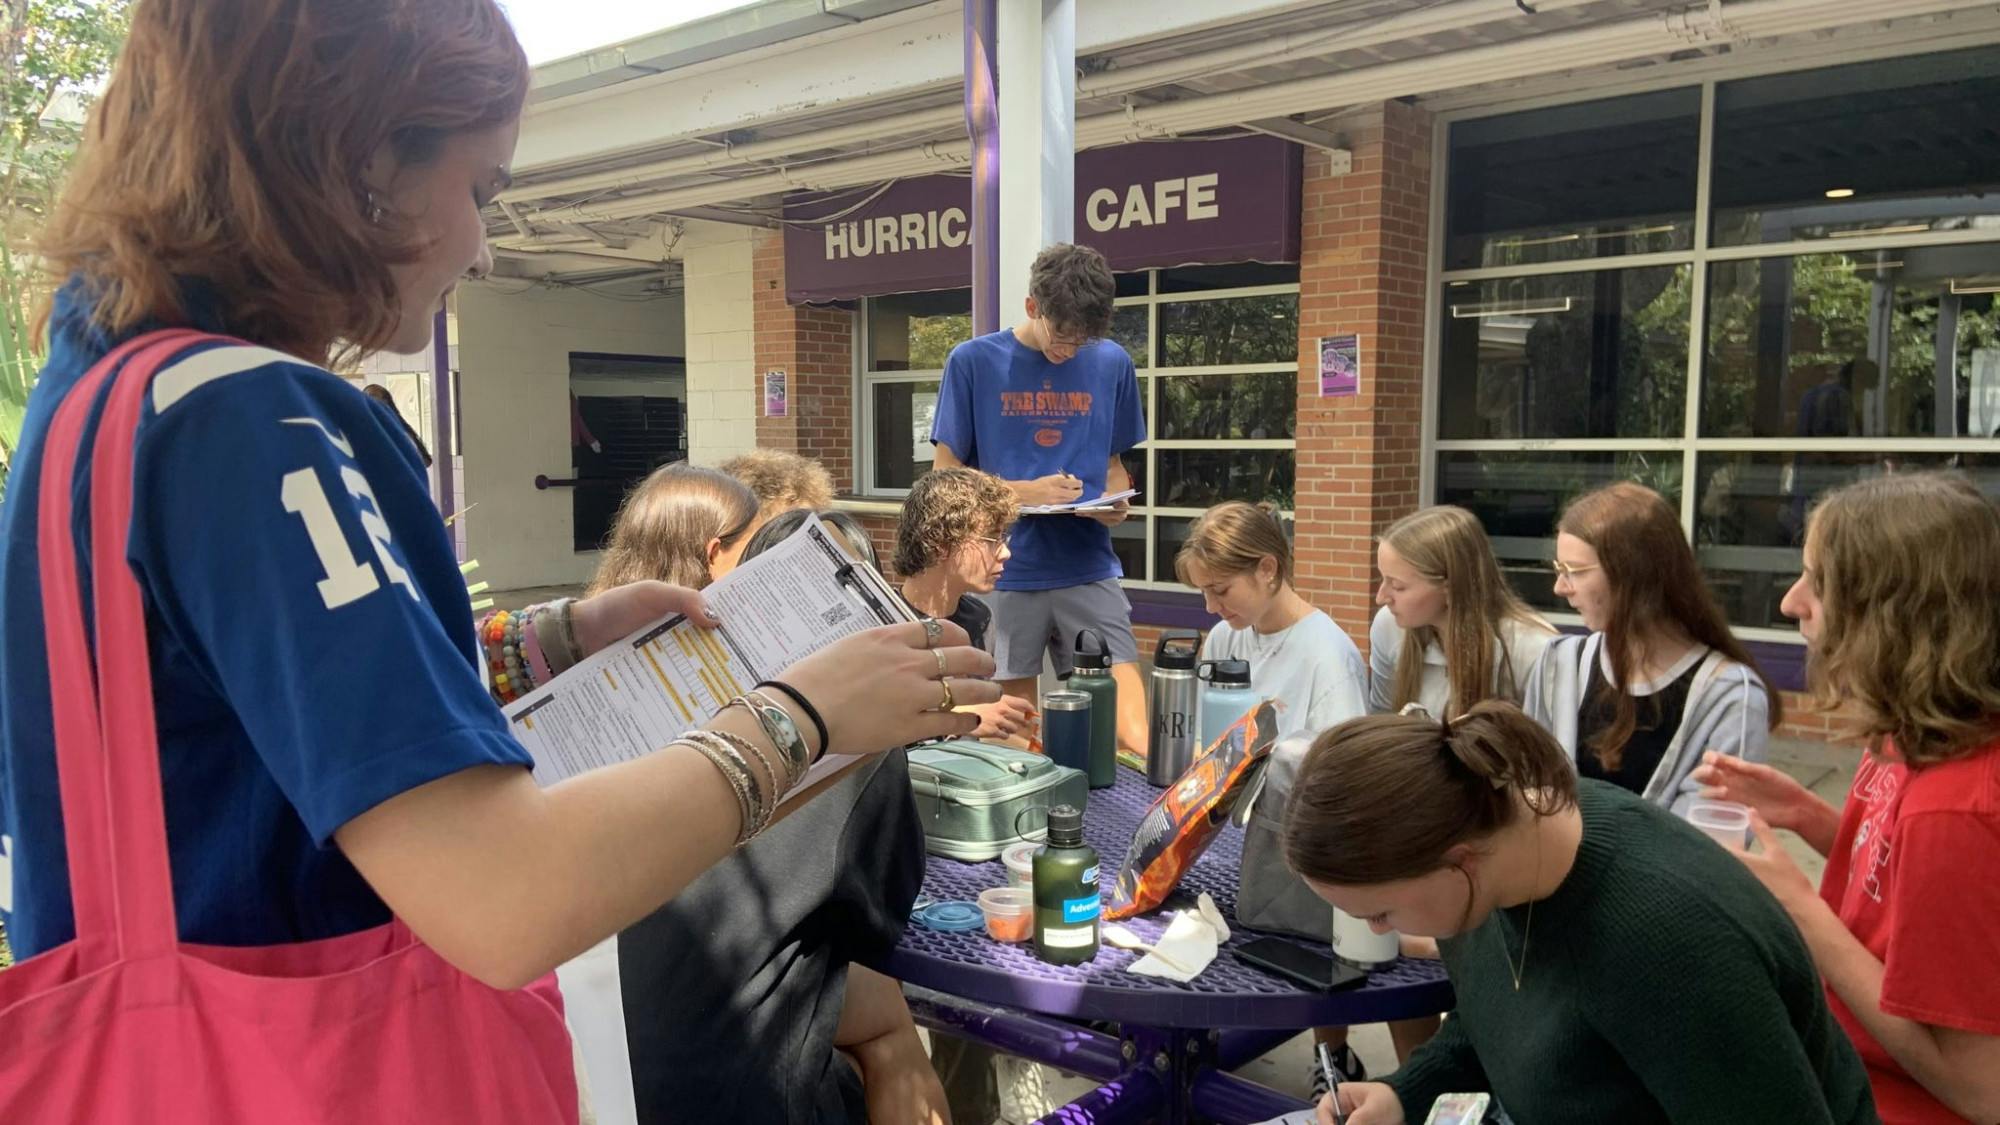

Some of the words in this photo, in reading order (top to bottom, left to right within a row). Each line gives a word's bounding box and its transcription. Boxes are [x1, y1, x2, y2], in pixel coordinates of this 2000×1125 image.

[825, 208, 973, 260] HURRIC
[1086, 173, 1219, 232] CAFE
[1001, 392, 1033, 410] THE
[1036, 392, 1093, 410] SWAMP
[281, 465, 420, 609] 12
